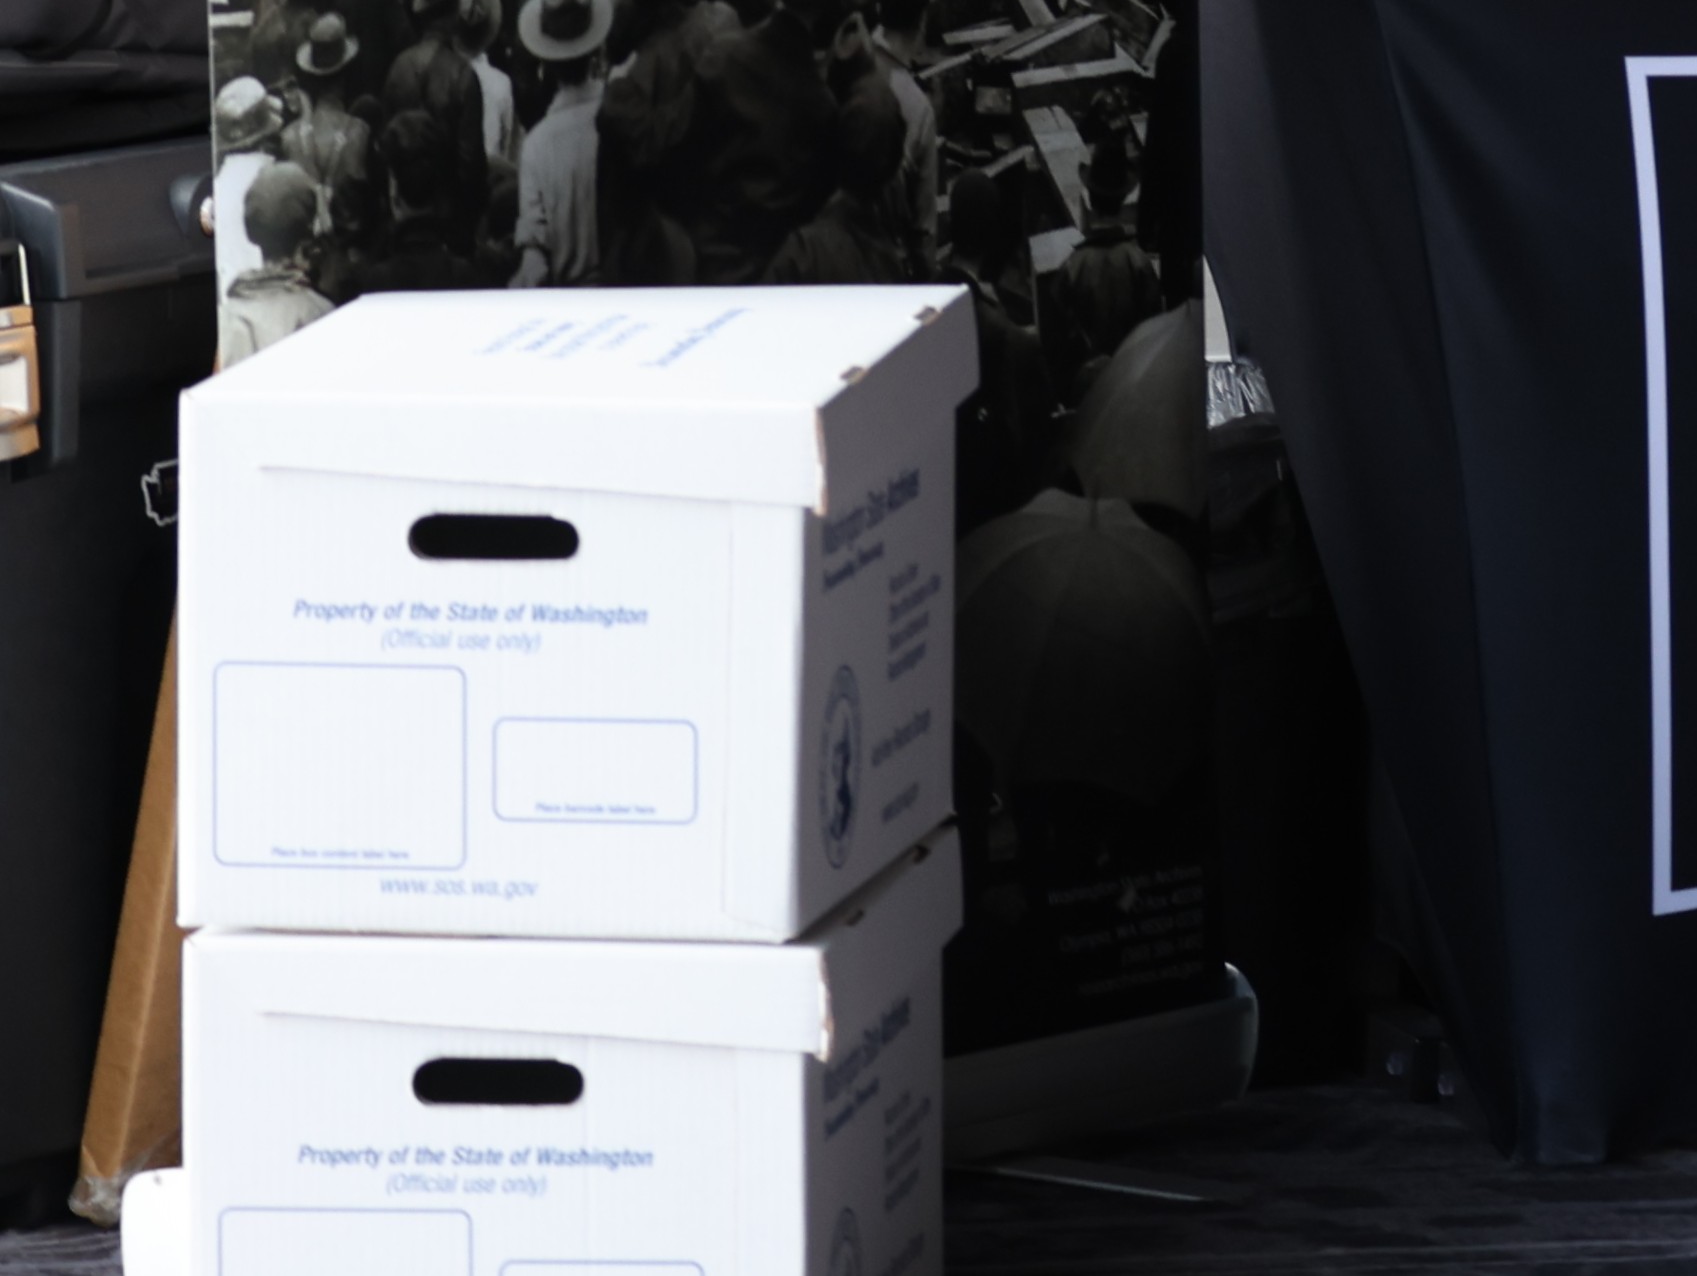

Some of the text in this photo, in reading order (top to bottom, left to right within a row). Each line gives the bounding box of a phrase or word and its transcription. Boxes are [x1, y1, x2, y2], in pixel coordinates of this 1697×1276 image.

[292, 597, 650, 630] Property of the State of Washington
[380, 627, 545, 654] (Official use only)
[379, 877, 540, 902] www.sos.wa.gov
[296, 1142, 655, 1174] Property of the State of Washington
[384, 1171, 550, 1199] (Official use only)
